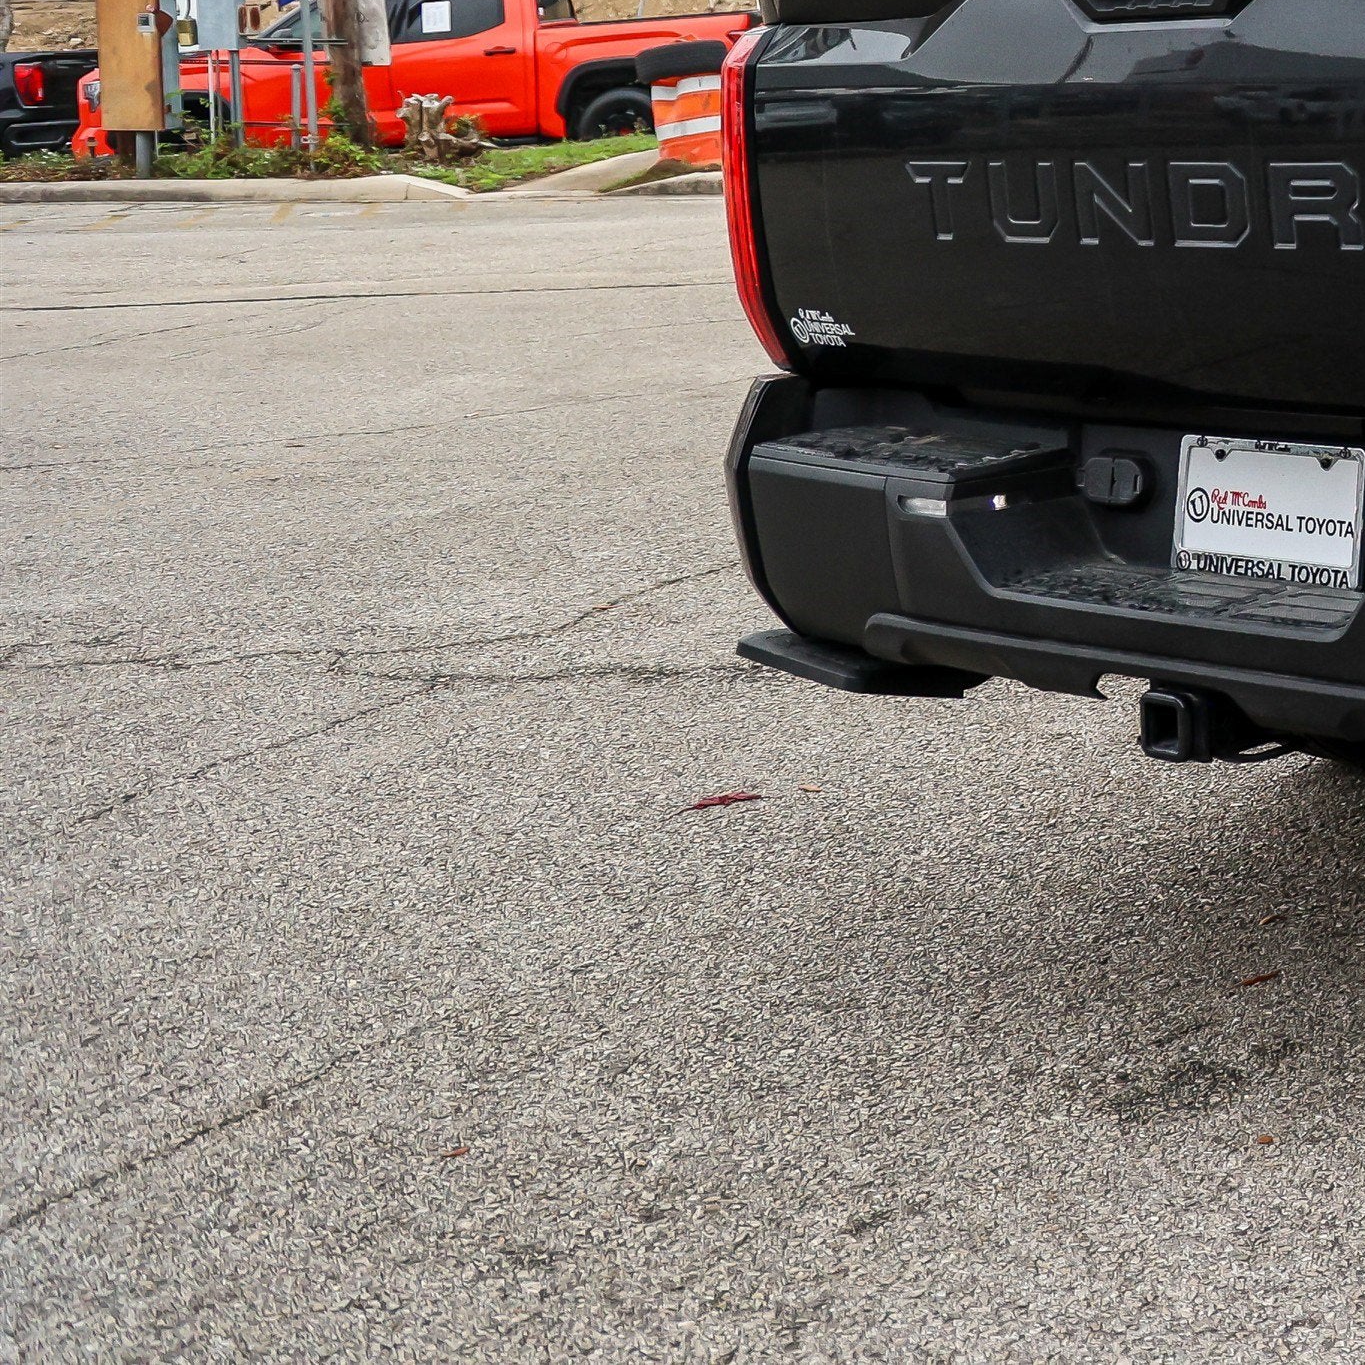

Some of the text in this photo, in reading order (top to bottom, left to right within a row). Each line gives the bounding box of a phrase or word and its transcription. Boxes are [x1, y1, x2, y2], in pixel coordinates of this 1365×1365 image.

[803, 317, 856, 336] UNIVERSAL
[809, 332, 847, 347] TOYOTA
[1211, 488, 1228, 510] Red
[1210, 508, 1294, 532] UNIVERSAL
[1297, 516, 1355, 539] TOYOTA
[1197, 553, 1287, 581] UNIVERSAL
[1289, 564, 1350, 589] TOYOTA
